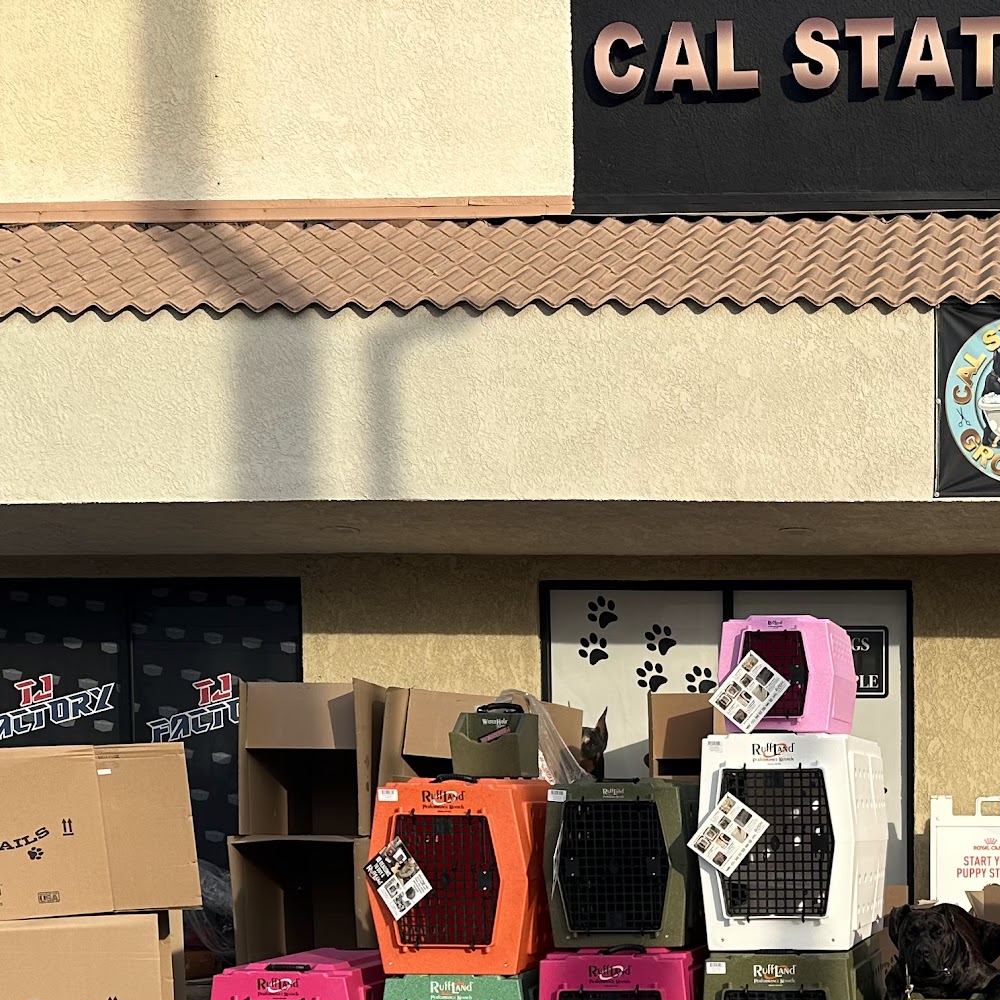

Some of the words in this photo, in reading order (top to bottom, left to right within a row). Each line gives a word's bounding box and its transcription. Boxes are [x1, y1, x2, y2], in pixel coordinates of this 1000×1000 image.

[594, 19, 759, 94] CAL
[953, 351, 987, 405] CAL
[956, 868, 987, 878] PUPPY
[963, 856, 992, 866] START
